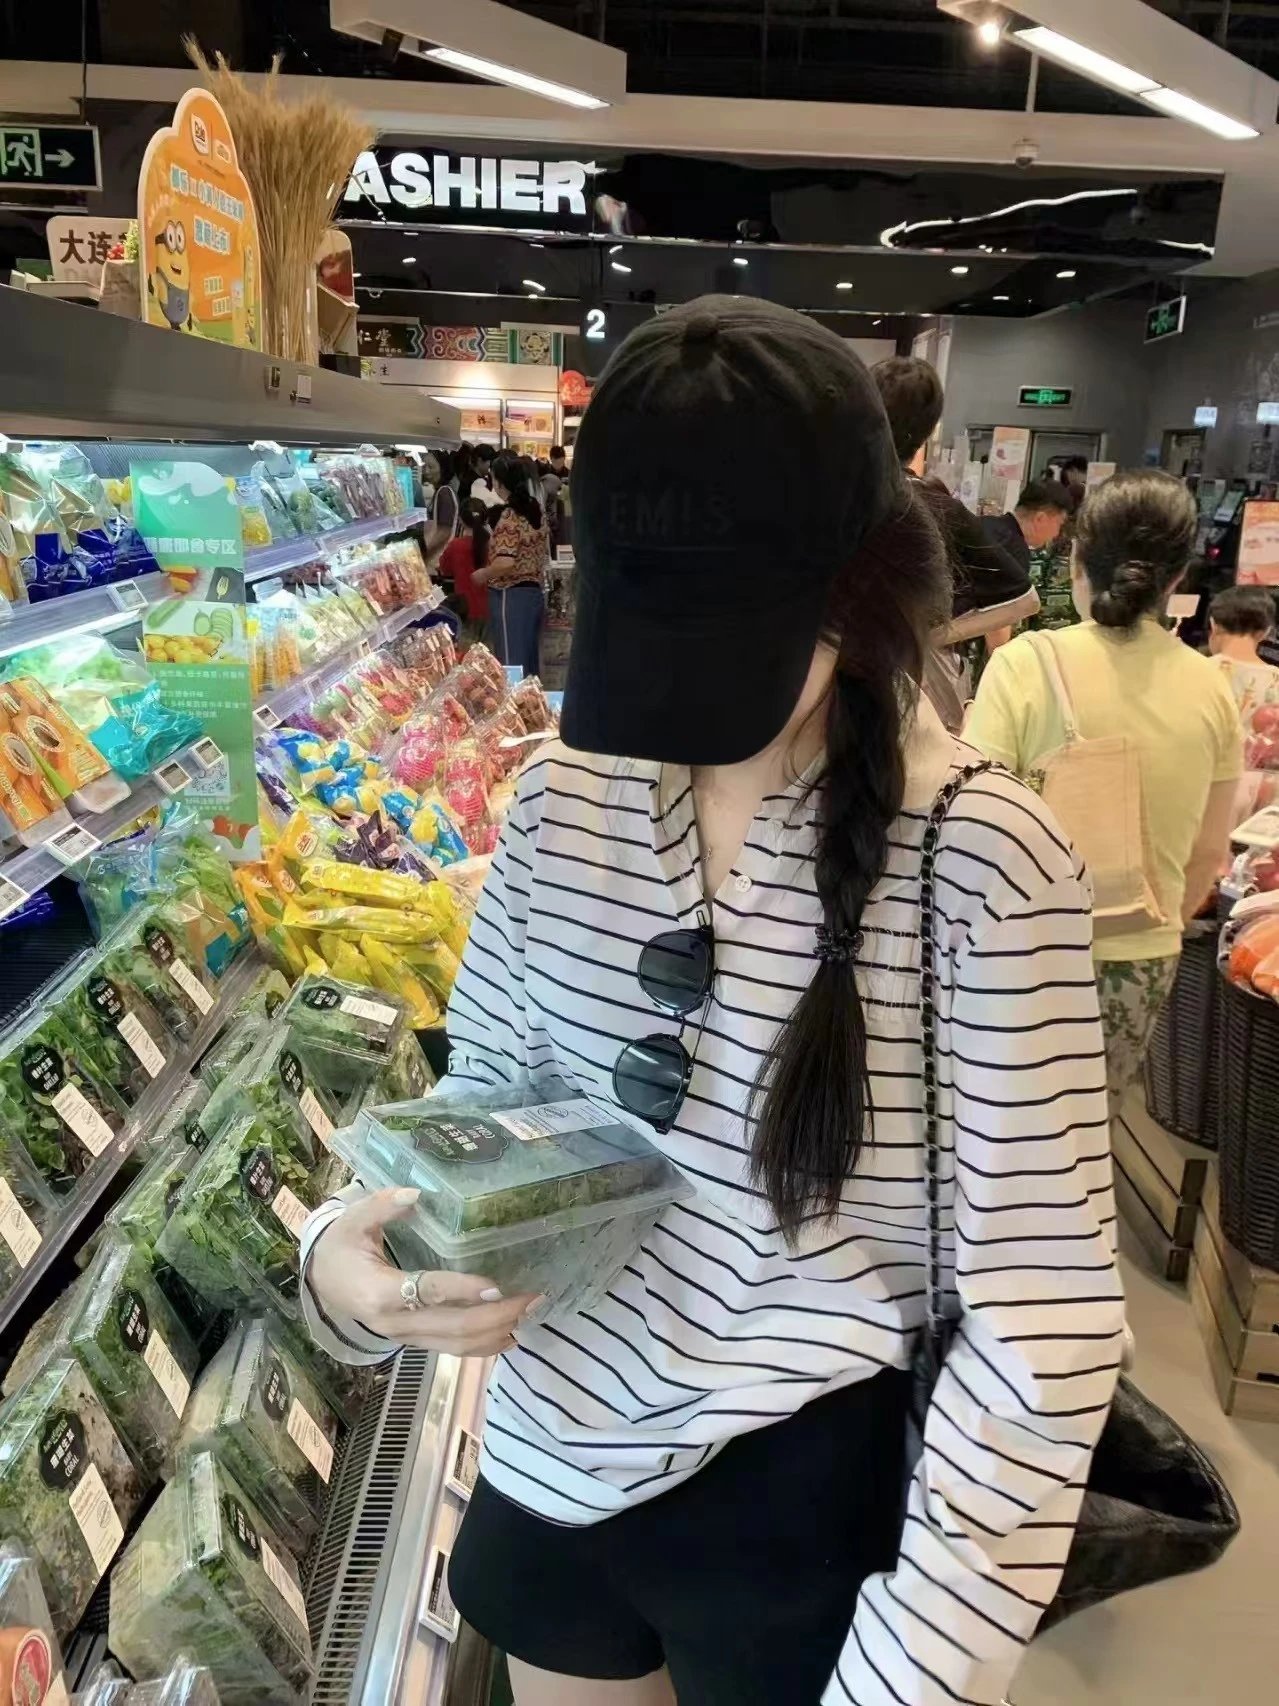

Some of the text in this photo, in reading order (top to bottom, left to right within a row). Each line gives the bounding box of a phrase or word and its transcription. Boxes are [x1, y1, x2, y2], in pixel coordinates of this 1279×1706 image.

[60, 229, 127, 265] 大连
[585, 309, 606, 339] 2
[609, 488, 735, 537] EMIS
